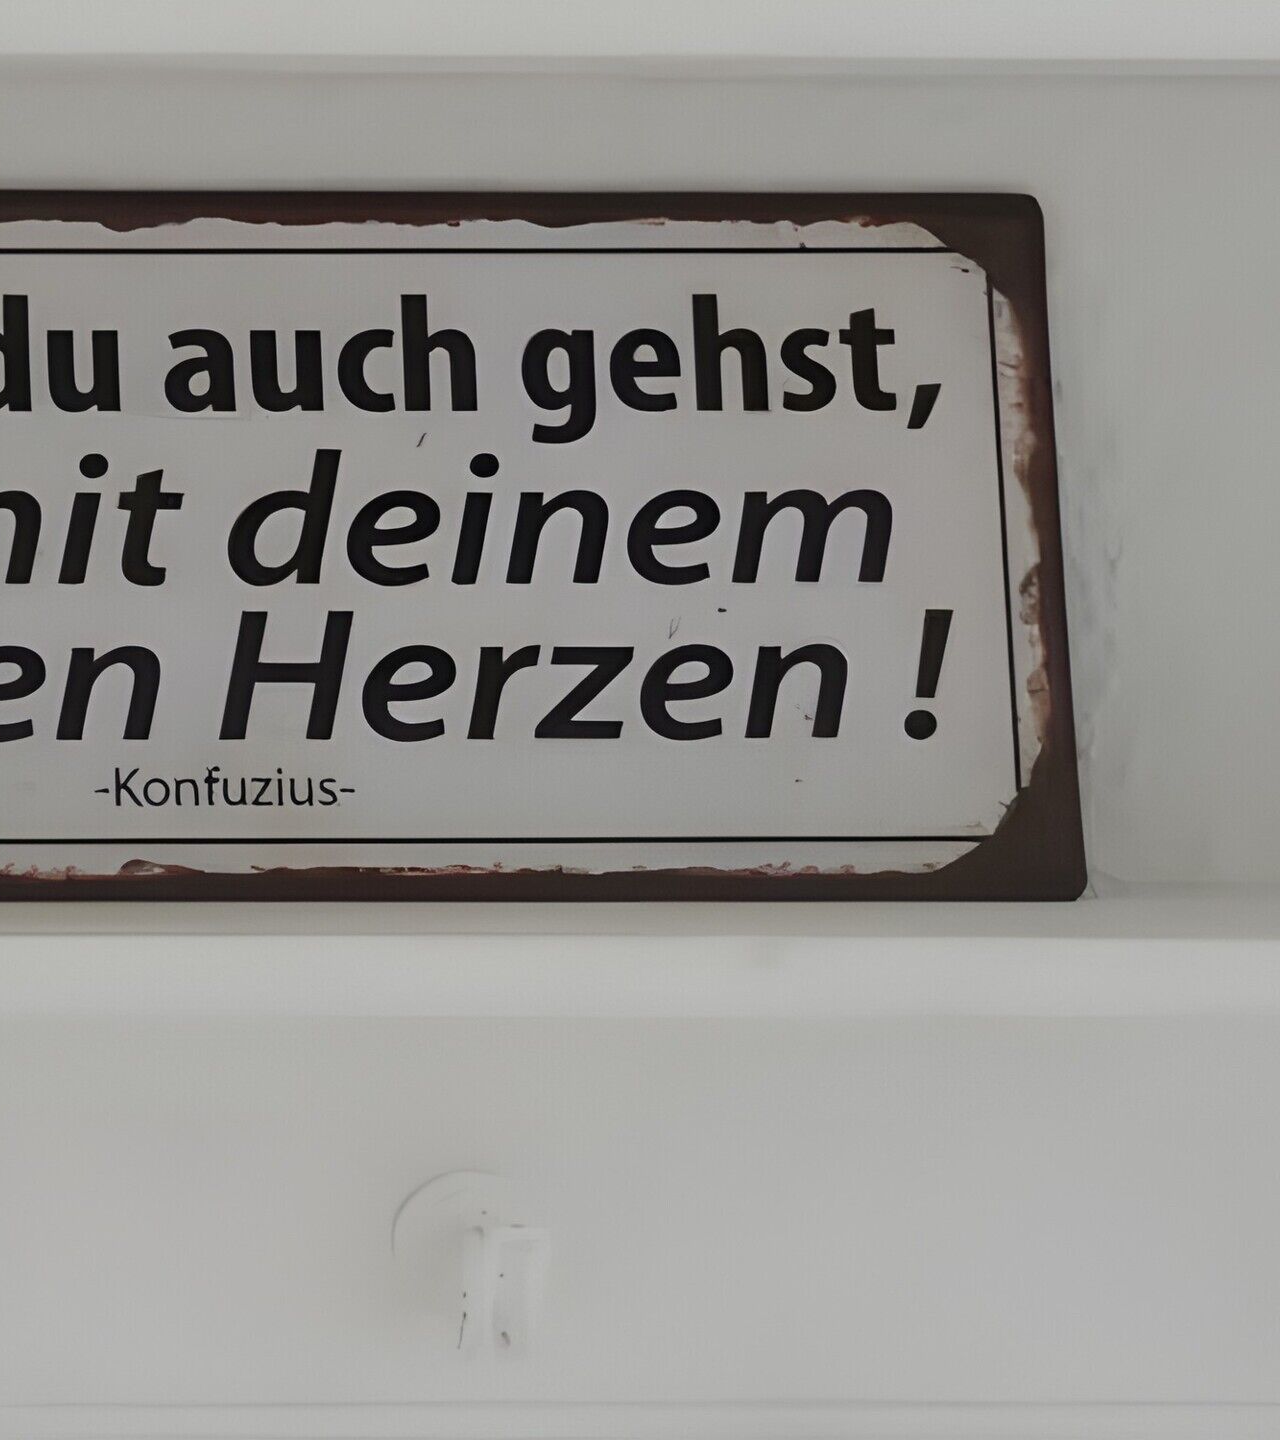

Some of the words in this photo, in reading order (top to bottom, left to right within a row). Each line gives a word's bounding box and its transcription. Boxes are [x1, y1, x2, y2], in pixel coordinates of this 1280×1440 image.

[164, 294, 477, 412] auch
[522, 294, 941, 444] gehst,
[228, 449, 892, 586] deinem
[219, 610, 847, 742] Herzen
[904, 609, 953, 740] !
[94, 766, 355, 807] -Konfuzius-
